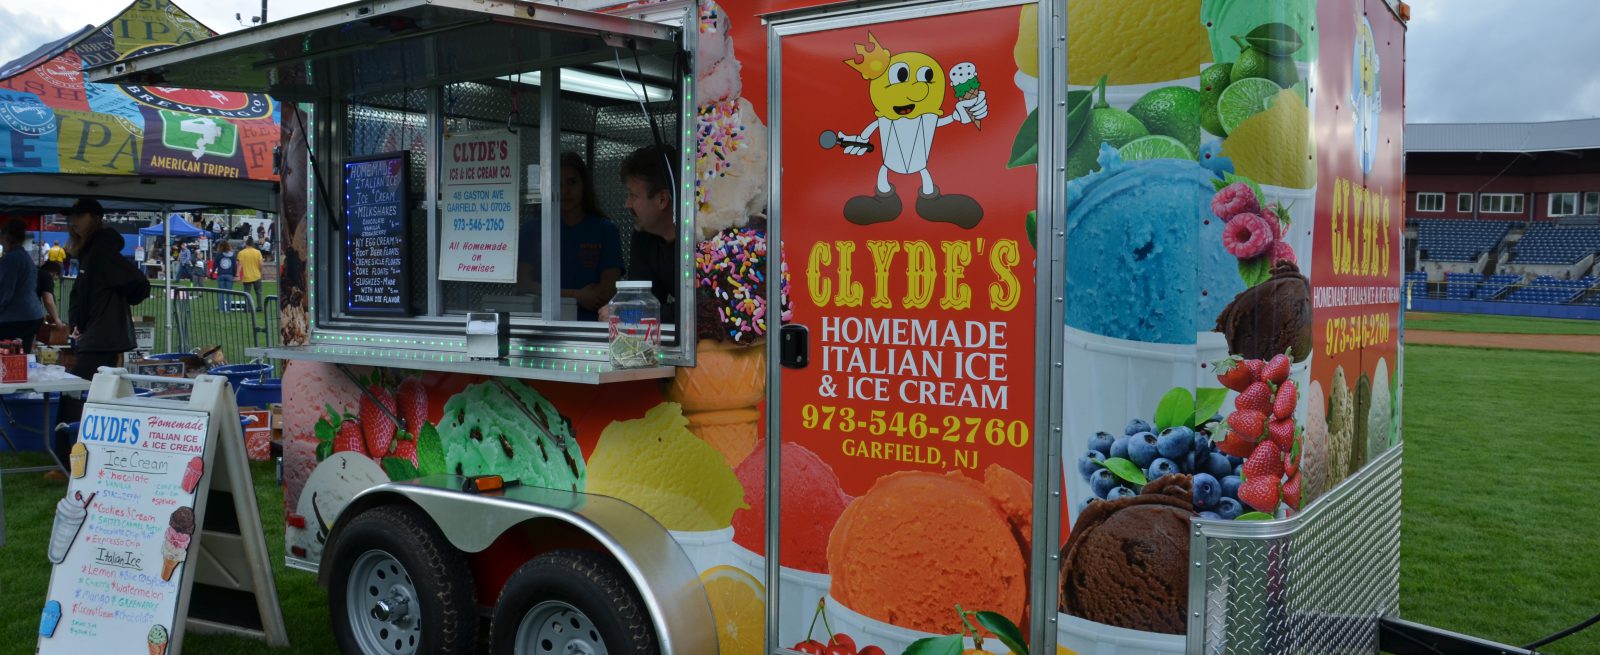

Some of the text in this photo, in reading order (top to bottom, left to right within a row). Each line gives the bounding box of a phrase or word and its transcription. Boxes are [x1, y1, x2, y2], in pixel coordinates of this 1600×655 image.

[127, 84, 251, 117] BREWING
[453, 140, 508, 162] CLYDE'S
[150, 155, 201, 173] AMERICAN
[476, 166, 498, 179] CREAM
[463, 190, 490, 200] GASTON
[491, 190, 504, 200] AVE
[480, 203, 489, 212] NJ
[453, 218, 505, 231] 973-546-2760
[1331, 175, 1391, 279] CLYDE'S
[448, 242, 508, 251] All Homemade
[457, 263, 496, 273] Premises
[805, 237, 1021, 312] CLYDE'S
[1313, 287, 1347, 308] HOMEMADE
[821, 316, 1008, 349] HOMEMADE
[1325, 312, 1390, 356] 973-546-2760
[822, 345, 1008, 382] ITALIAN ICE
[818, 374, 1009, 410] & ICE CREAM
[82, 414, 141, 445] CLYDE'S
[147, 416, 203, 430] Homemade
[801, 403, 1030, 448] 973-546-2760
[148, 431, 198, 442] ITALIAN ICE
[151, 442, 167, 450] ICE
[169, 443, 203, 452] CREAM
[841, 438, 979, 470] GARFIELD, NJ
